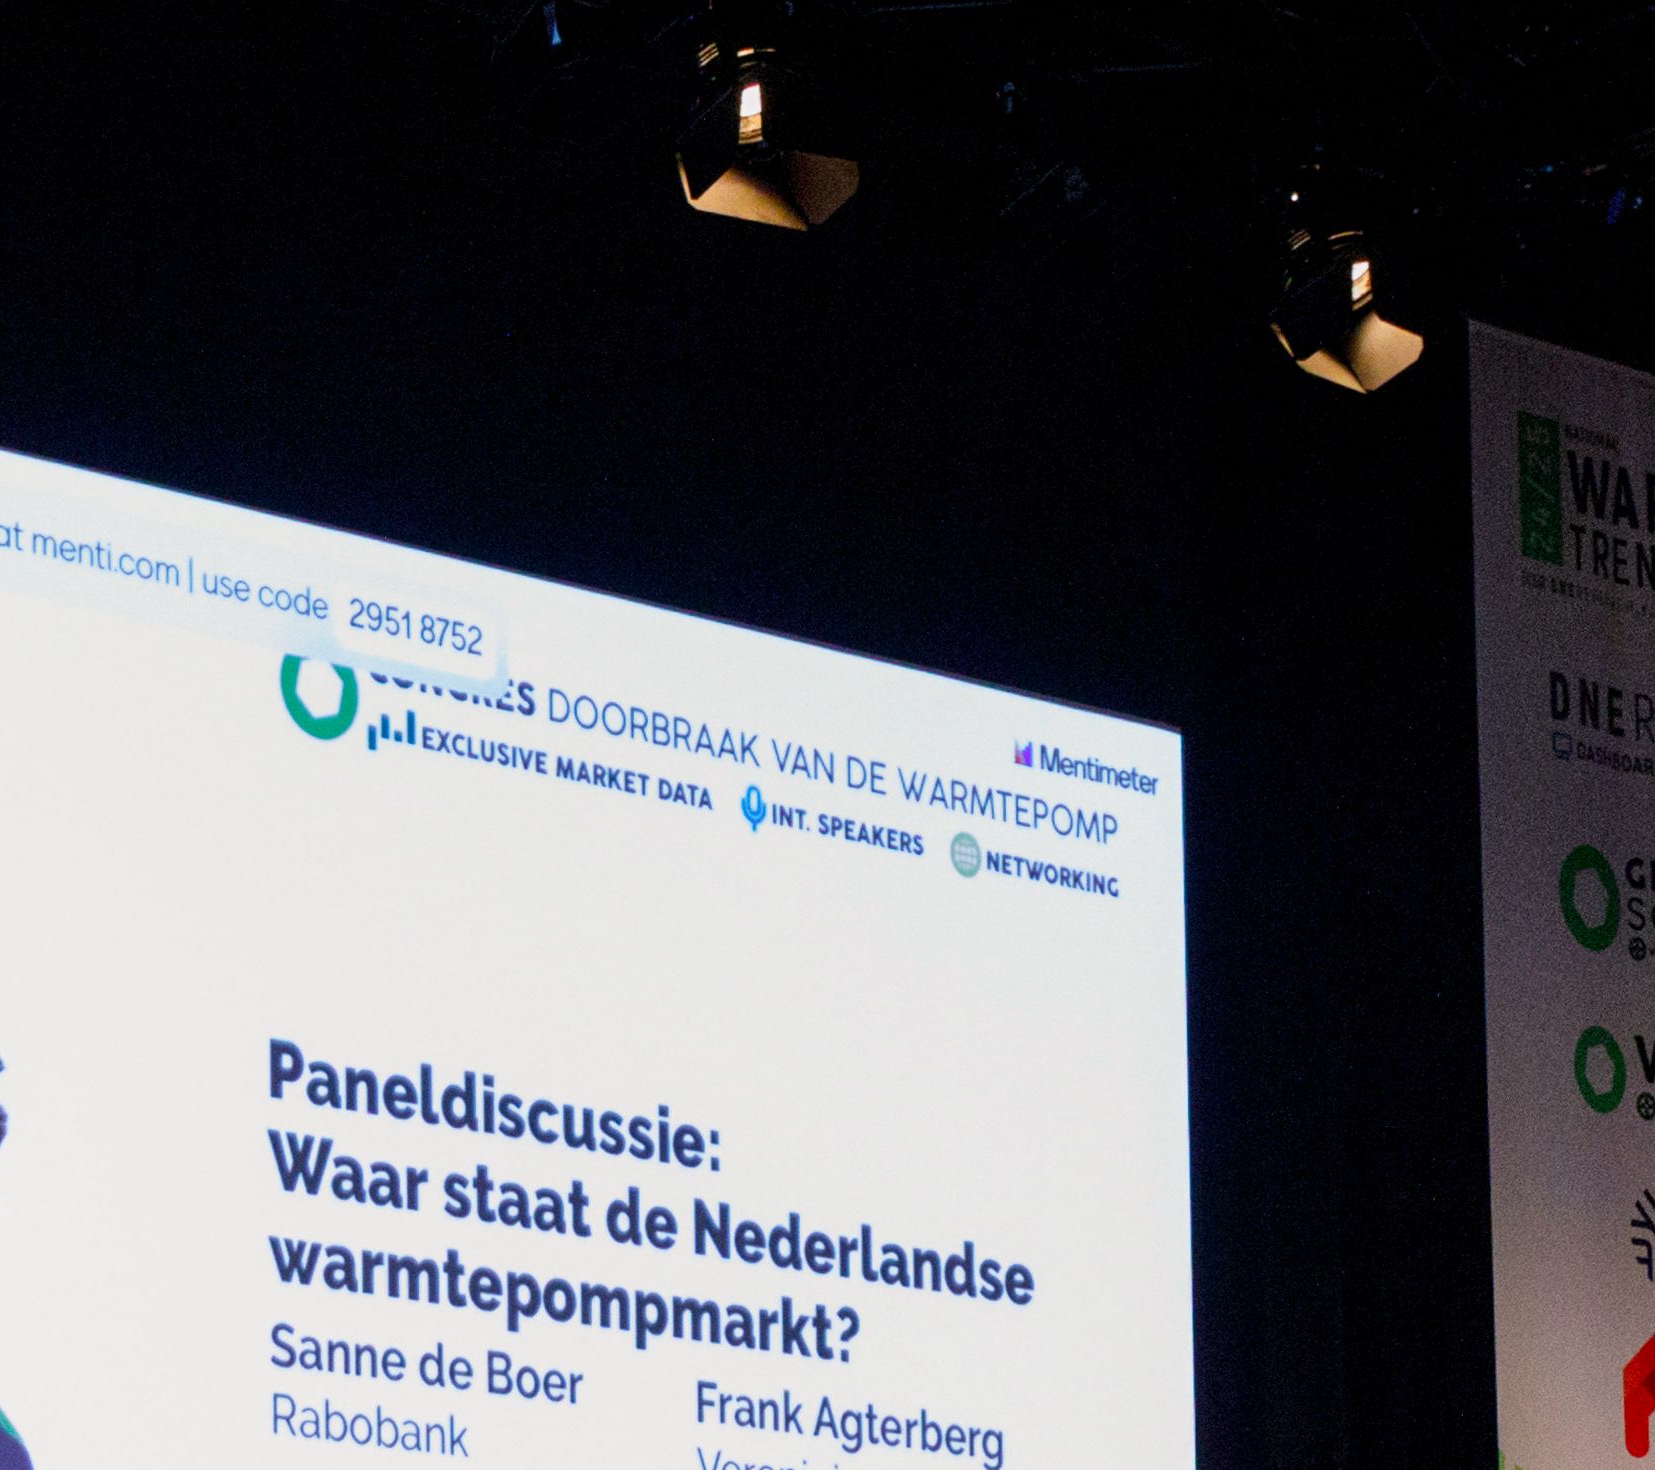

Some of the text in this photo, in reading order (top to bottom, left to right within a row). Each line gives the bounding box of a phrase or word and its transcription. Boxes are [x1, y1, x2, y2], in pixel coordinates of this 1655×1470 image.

[32, 529, 180, 587] menti.com
[202, 571, 250, 602] use
[258, 579, 329, 620] code
[349, 598, 413, 640] 2951
[420, 613, 484, 656] 8752
[421, 726, 714, 811] EXCLUSIVE MARKET DATA
[548, 688, 761, 768] DOORBRAAK
[772, 738, 835, 784] VAN
[847, 755, 888, 795] DE
[898, 767, 1119, 845] WARMTEPOMP
[1040, 745, 1159, 795] Mentimeter
[772, 803, 925, 856] INT. SPEAKERS
[986, 851, 1120, 898] NETWORKING
[268, 1037, 722, 1172] Paneldiscussie:
[267, 1128, 1036, 1308] Waar staat de Nederlandse
[268, 1234, 860, 1365] warmtepompmarkt?
[270, 1322, 584, 1405] Sanne de Boer
[270, 1391, 470, 1460] Rabobank
[695, 1381, 805, 1438] Frank
